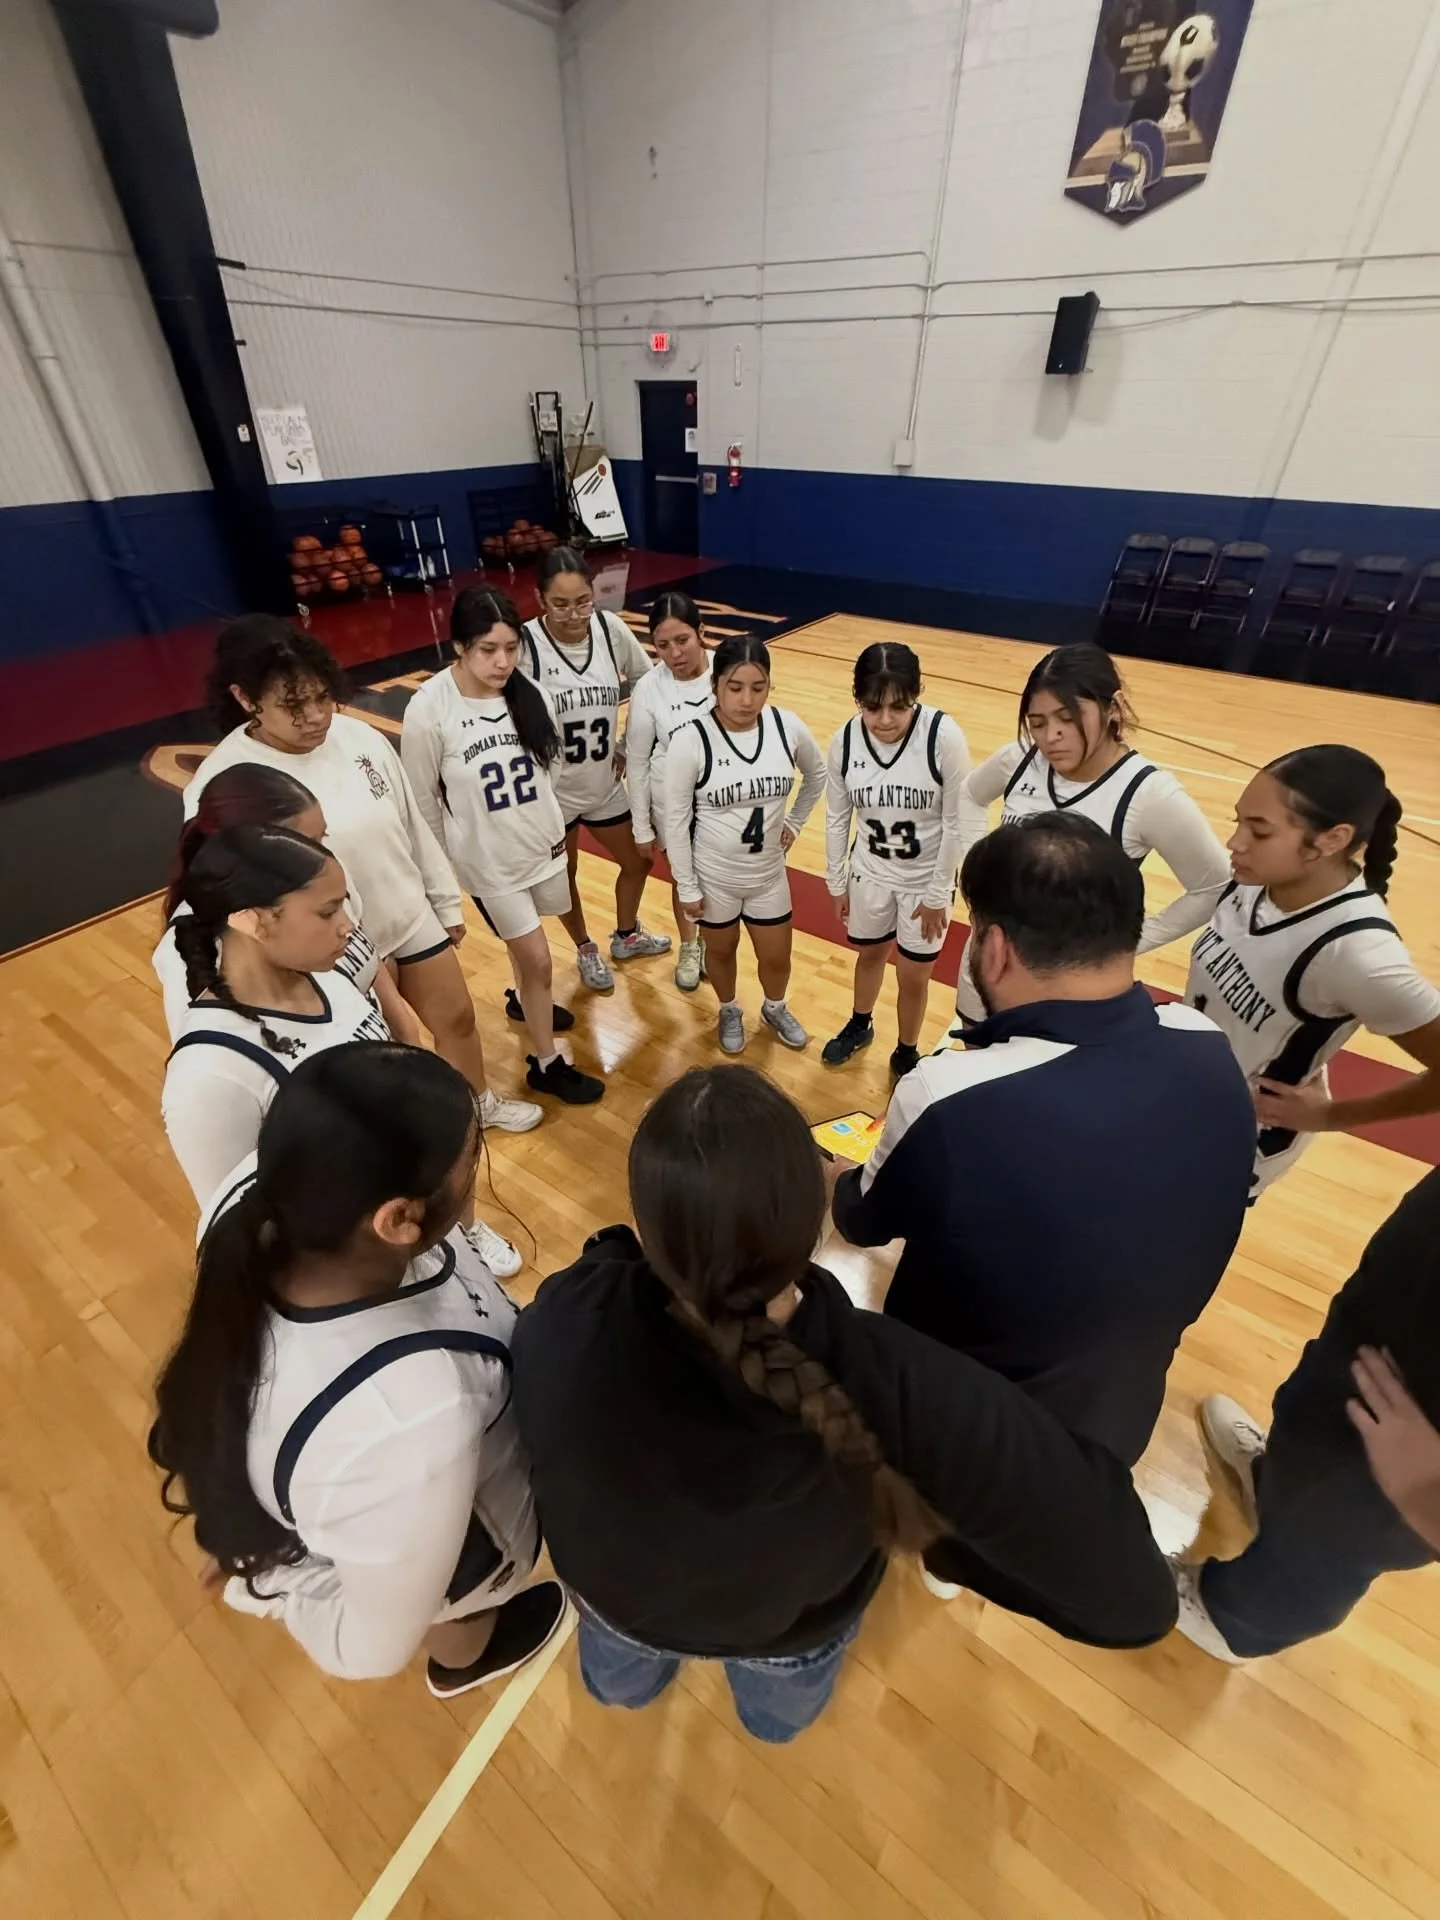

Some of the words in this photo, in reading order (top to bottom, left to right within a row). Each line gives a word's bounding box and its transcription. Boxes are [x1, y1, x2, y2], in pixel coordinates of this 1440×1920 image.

[555, 690, 573, 714] INT
[463, 734, 497, 765] ROMAN
[497, 733, 520, 747] LEG
[563, 716, 610, 764] 53
[480, 755, 538, 813] 22
[707, 781, 743, 808] SAINT
[878, 784, 935, 810] ANTHONY
[741, 807, 764, 854] 4
[866, 818, 921, 860] 23
[1205, 946, 1276, 1033] ANTHONY
